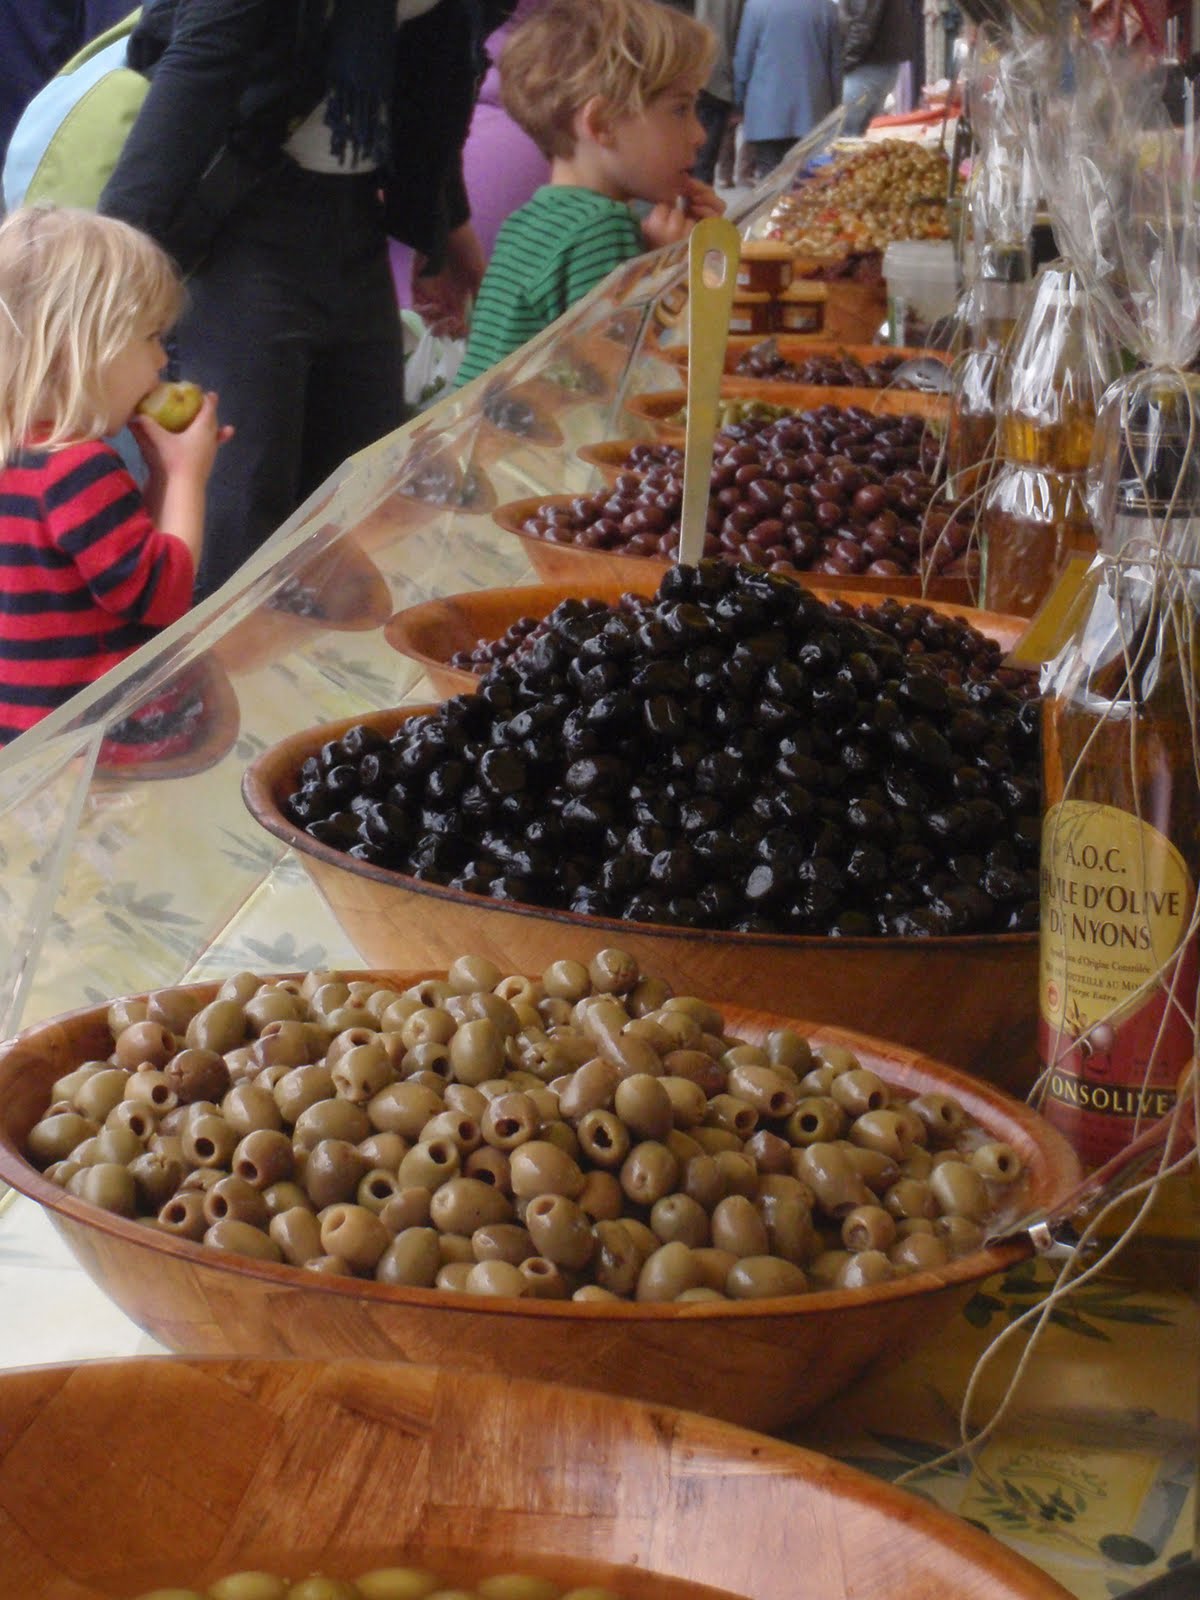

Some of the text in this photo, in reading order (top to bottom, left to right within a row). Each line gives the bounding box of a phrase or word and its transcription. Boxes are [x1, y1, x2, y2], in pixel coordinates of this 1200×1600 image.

[1065, 842, 1126, 874] A.O.C.
[1084, 885, 1179, 917] D'OLIVE
[1072, 913, 1151, 950] NYONS
